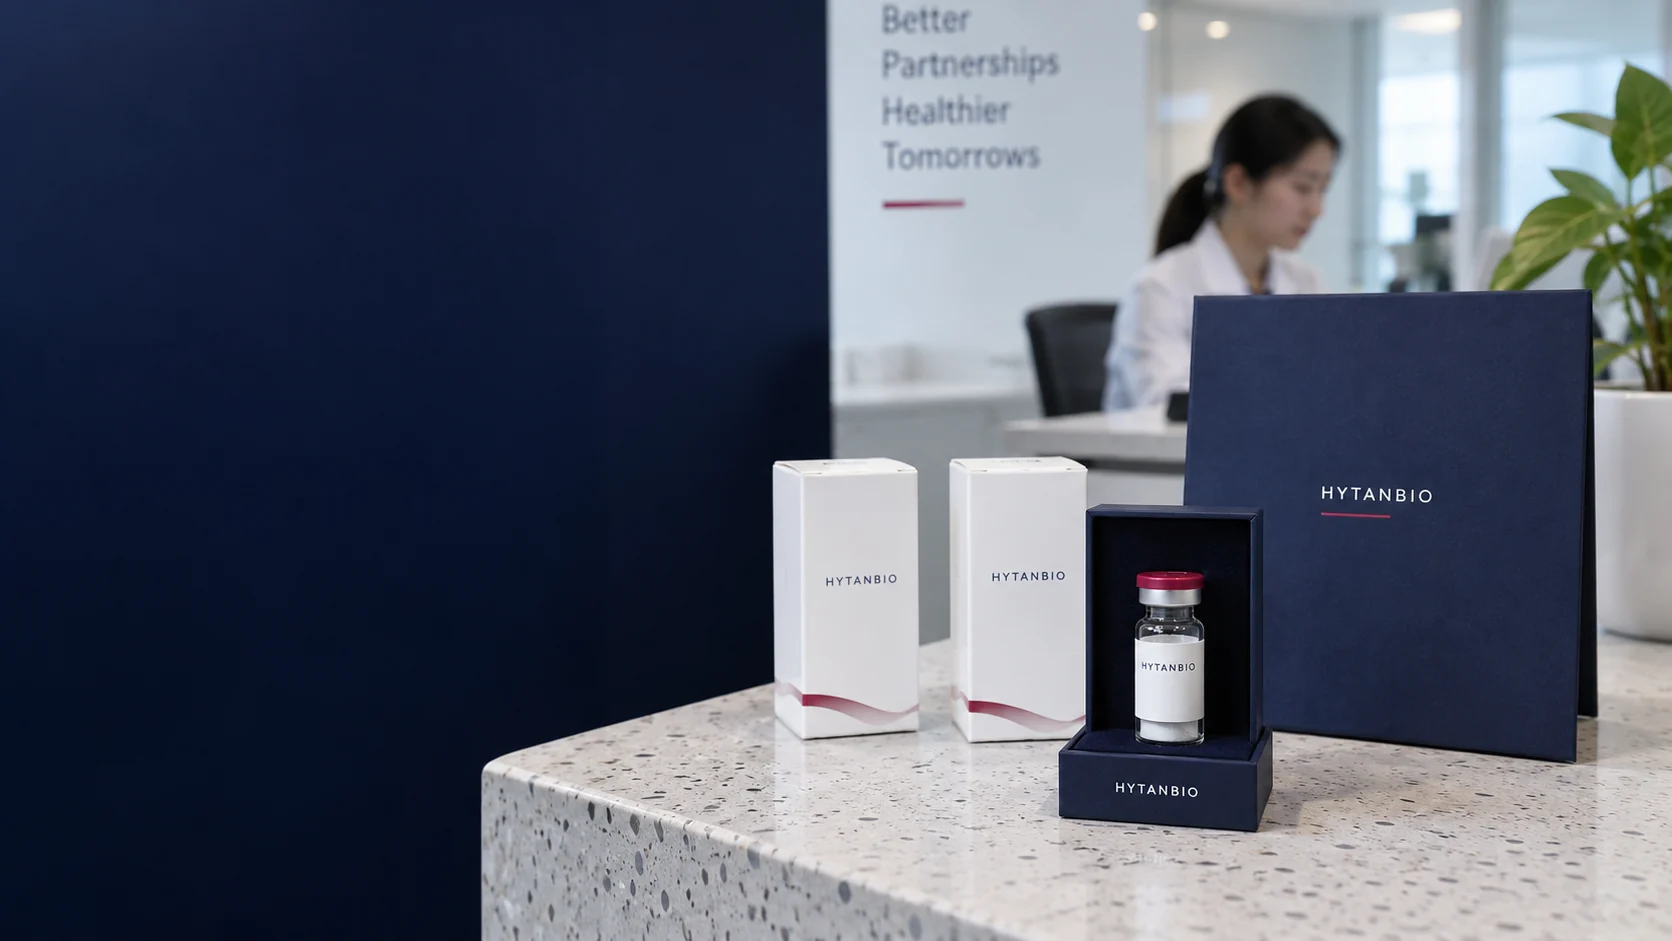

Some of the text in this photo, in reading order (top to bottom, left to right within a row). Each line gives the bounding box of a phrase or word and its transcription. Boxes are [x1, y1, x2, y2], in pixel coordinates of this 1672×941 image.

[882, 4, 971, 35] Better
[882, 47, 1061, 84] Partnerships
[882, 94, 1010, 126] Healthier
[881, 141, 1042, 170] Tomorrows
[1321, 485, 1433, 504] HYTANBIO
[825, 573, 898, 587] HYTANBIO
[991, 570, 1066, 582] HYTANBIO
[1140, 661, 1196, 673] HYTANBIO
[1115, 781, 1199, 799] HYTANBIO
